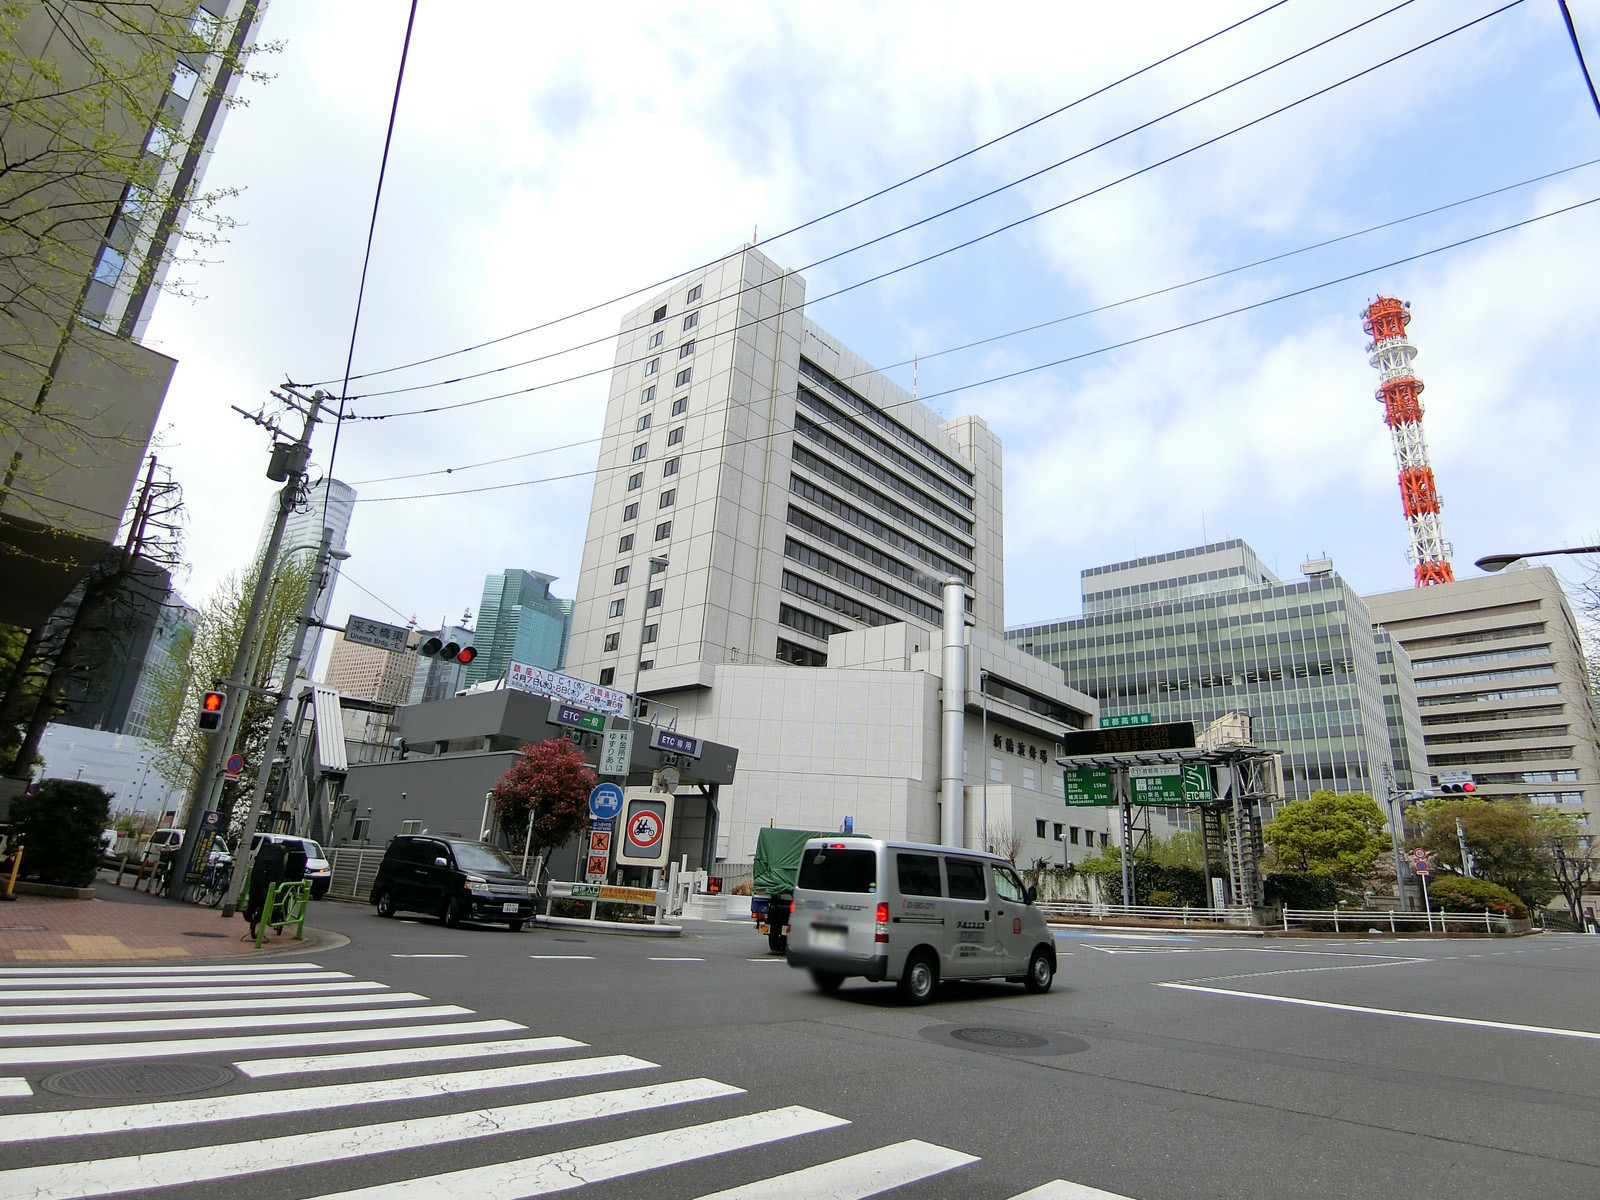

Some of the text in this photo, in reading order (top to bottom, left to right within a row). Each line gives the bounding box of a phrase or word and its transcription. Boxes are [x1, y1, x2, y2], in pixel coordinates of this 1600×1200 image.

[350, 632, 372, 642] Uneme
[562, 710, 580, 721] ETC
[1102, 715, 1148, 726] 首都高情報
[661, 735, 675, 746] ETC
[604, 733, 617, 772] ゆずりあい
[616, 733, 628, 773] 料金所では
